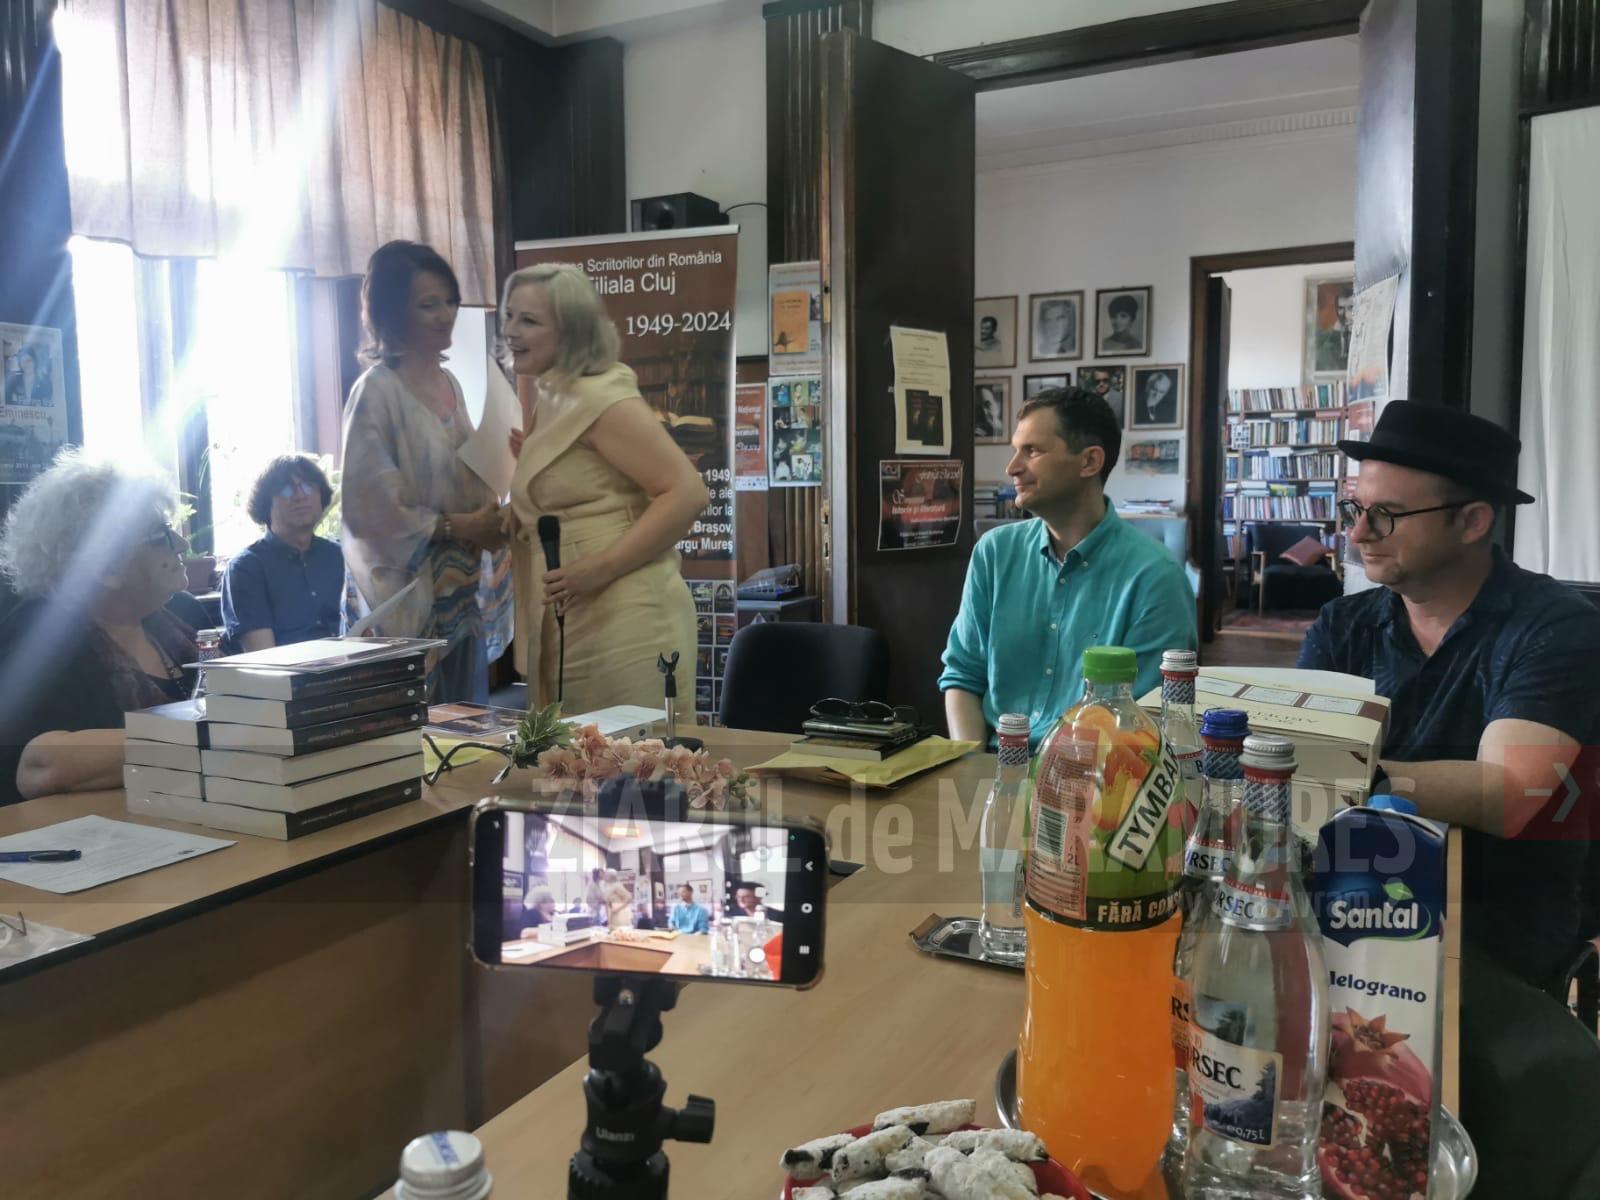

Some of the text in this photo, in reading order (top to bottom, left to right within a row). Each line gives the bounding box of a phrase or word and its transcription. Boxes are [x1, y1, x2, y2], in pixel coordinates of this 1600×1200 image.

[587, 255, 645, 272] Scriitorilor
[647, 254, 665, 268] din
[669, 250, 722, 266] România
[590, 271, 676, 295] iliala Cluj
[626, 311, 731, 337] 1949-2024
[719, 486, 734, 499] ale
[725, 503, 734, 516] la
[1098, 898, 1143, 924] FĂRĂ
[1330, 900, 1419, 930] Santal
